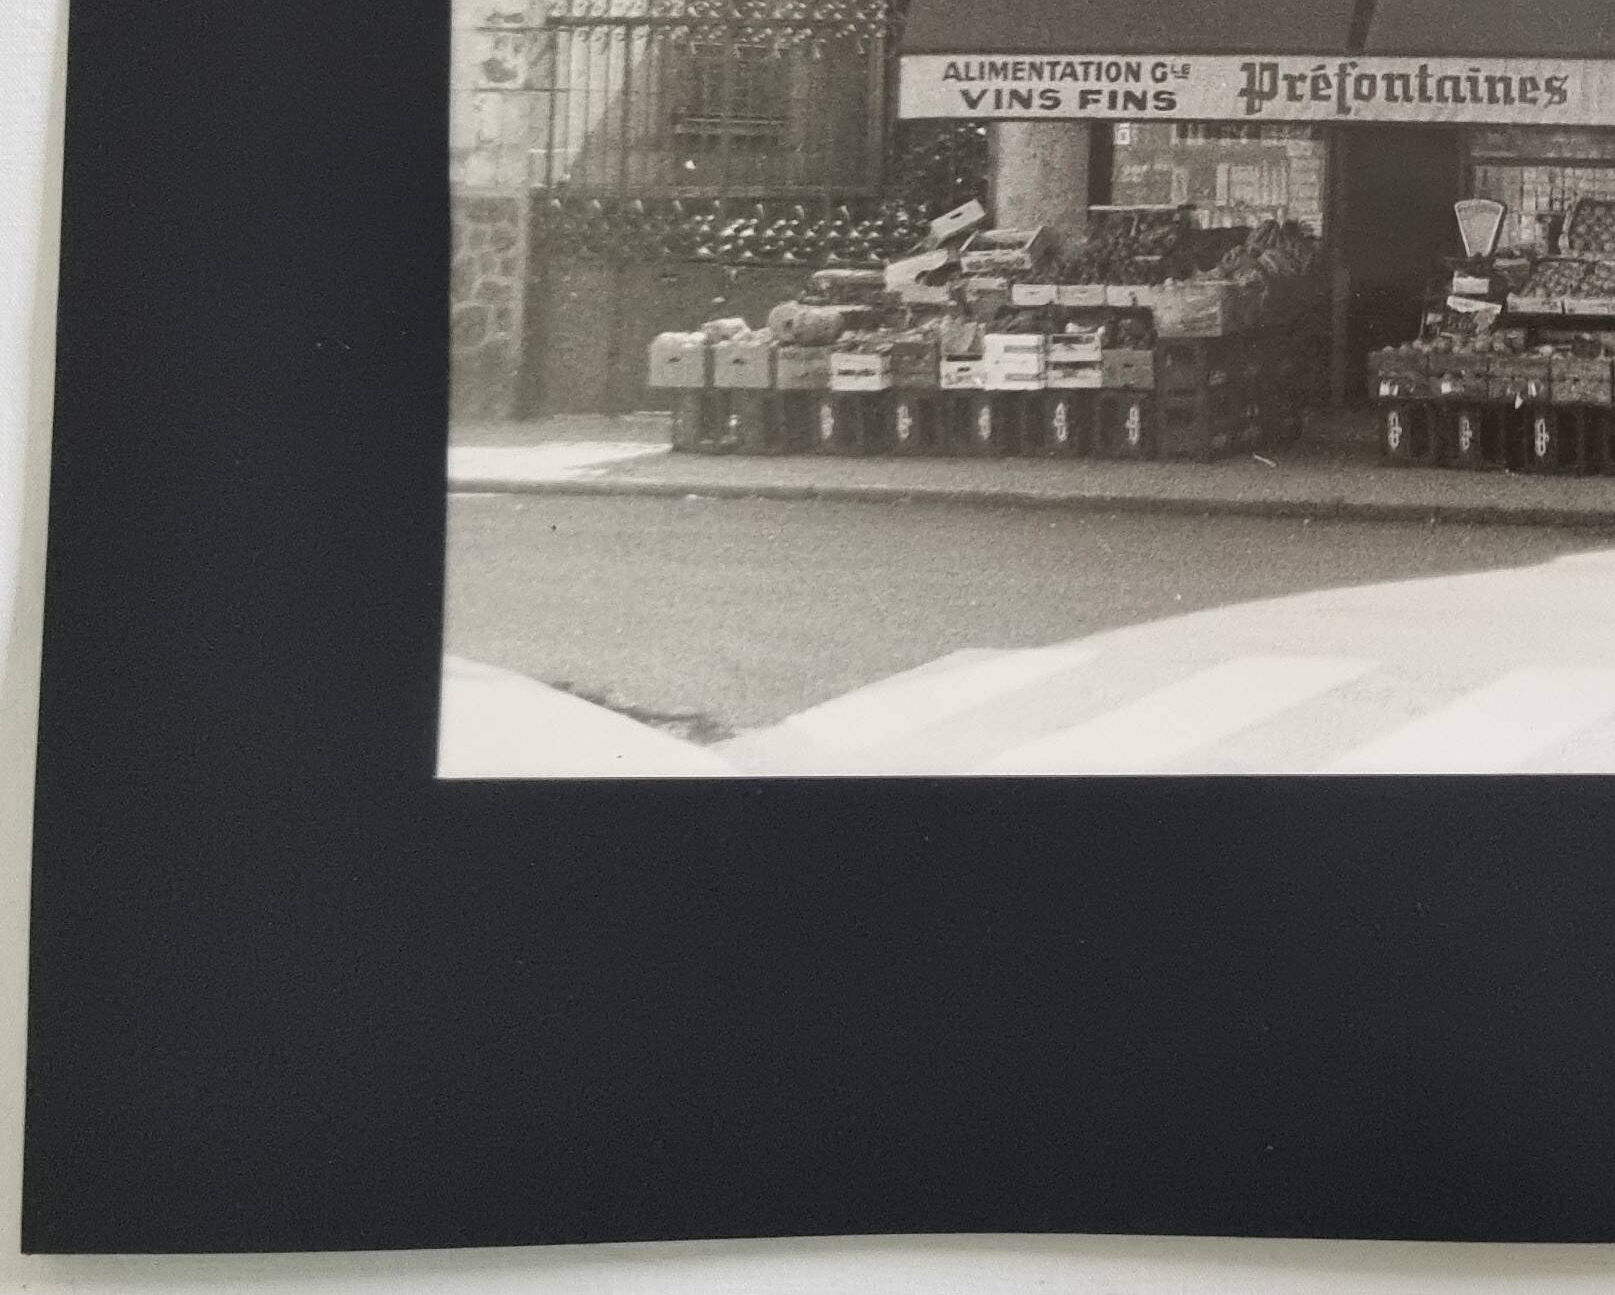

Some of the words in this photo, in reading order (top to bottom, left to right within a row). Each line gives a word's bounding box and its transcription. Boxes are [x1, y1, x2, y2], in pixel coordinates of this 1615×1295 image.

[942, 61, 1141, 82] ALIMENTATION
[960, 88, 1062, 110] VINS
[1079, 90, 1177, 111] FINS
[1238, 61, 1569, 115] Préfontaines
